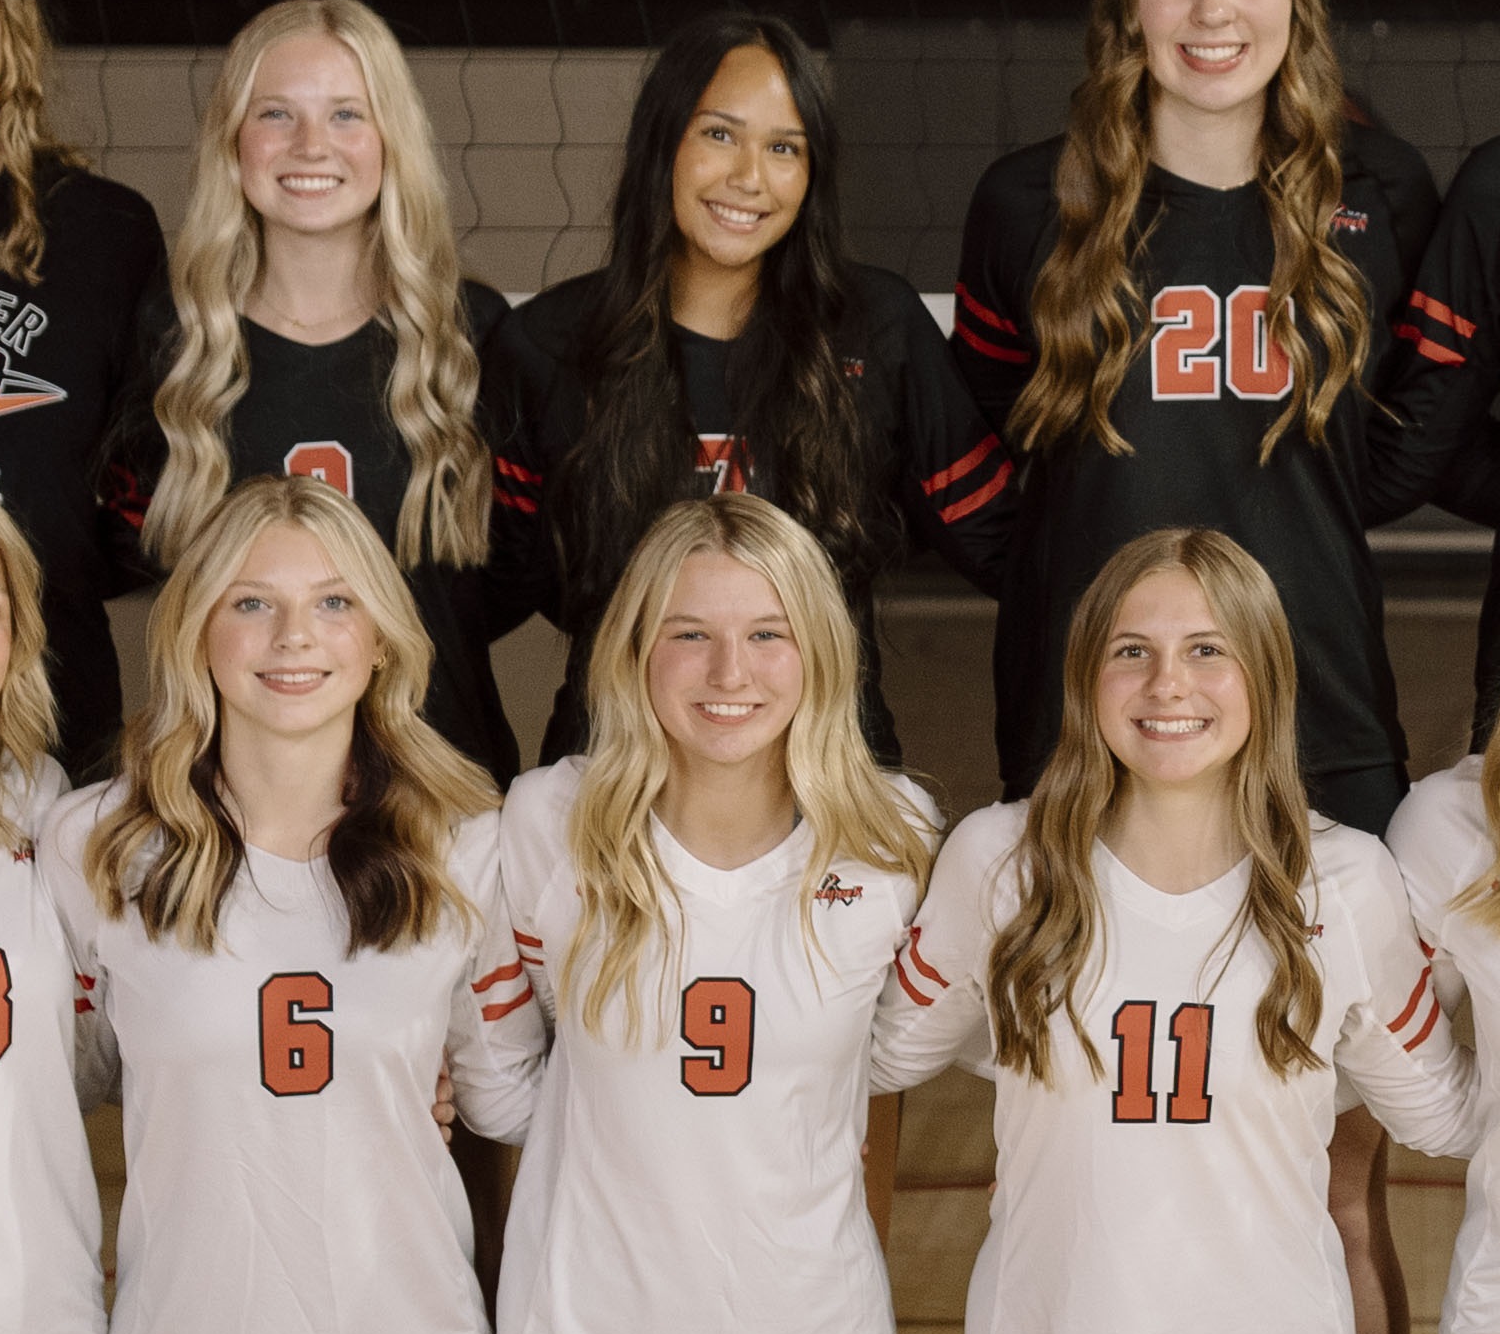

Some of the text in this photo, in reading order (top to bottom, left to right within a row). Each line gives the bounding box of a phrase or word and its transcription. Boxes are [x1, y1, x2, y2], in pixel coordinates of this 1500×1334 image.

[1151, 285, 1295, 401] 20
[258, 971, 333, 1097] 6
[680, 977, 756, 1097] 9
[1111, 1000, 1215, 1124] 11
